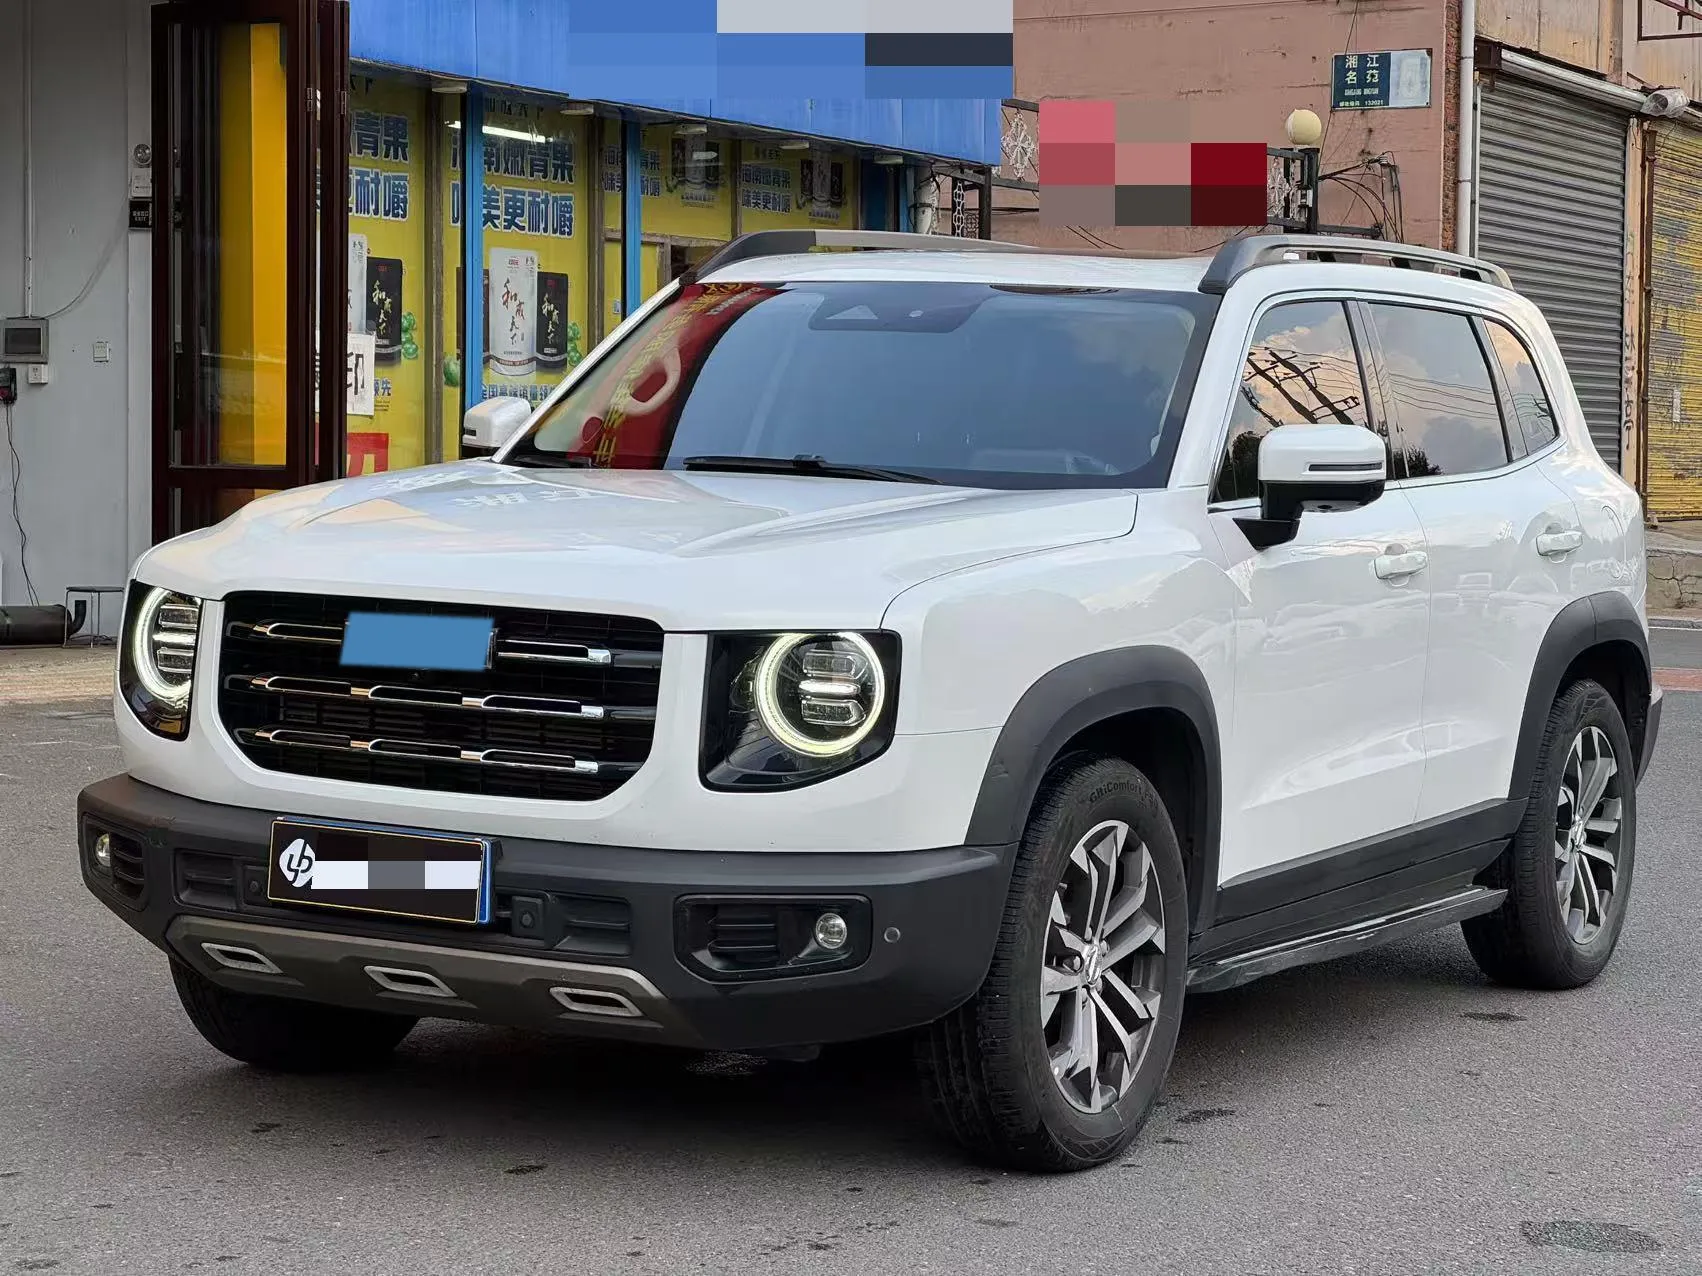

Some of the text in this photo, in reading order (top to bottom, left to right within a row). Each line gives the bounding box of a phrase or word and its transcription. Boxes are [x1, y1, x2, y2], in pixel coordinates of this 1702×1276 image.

[1345, 54, 1380, 69] 湘江
[349, 111, 409, 163] 青果
[349, 168, 409, 222] 耐嚼
